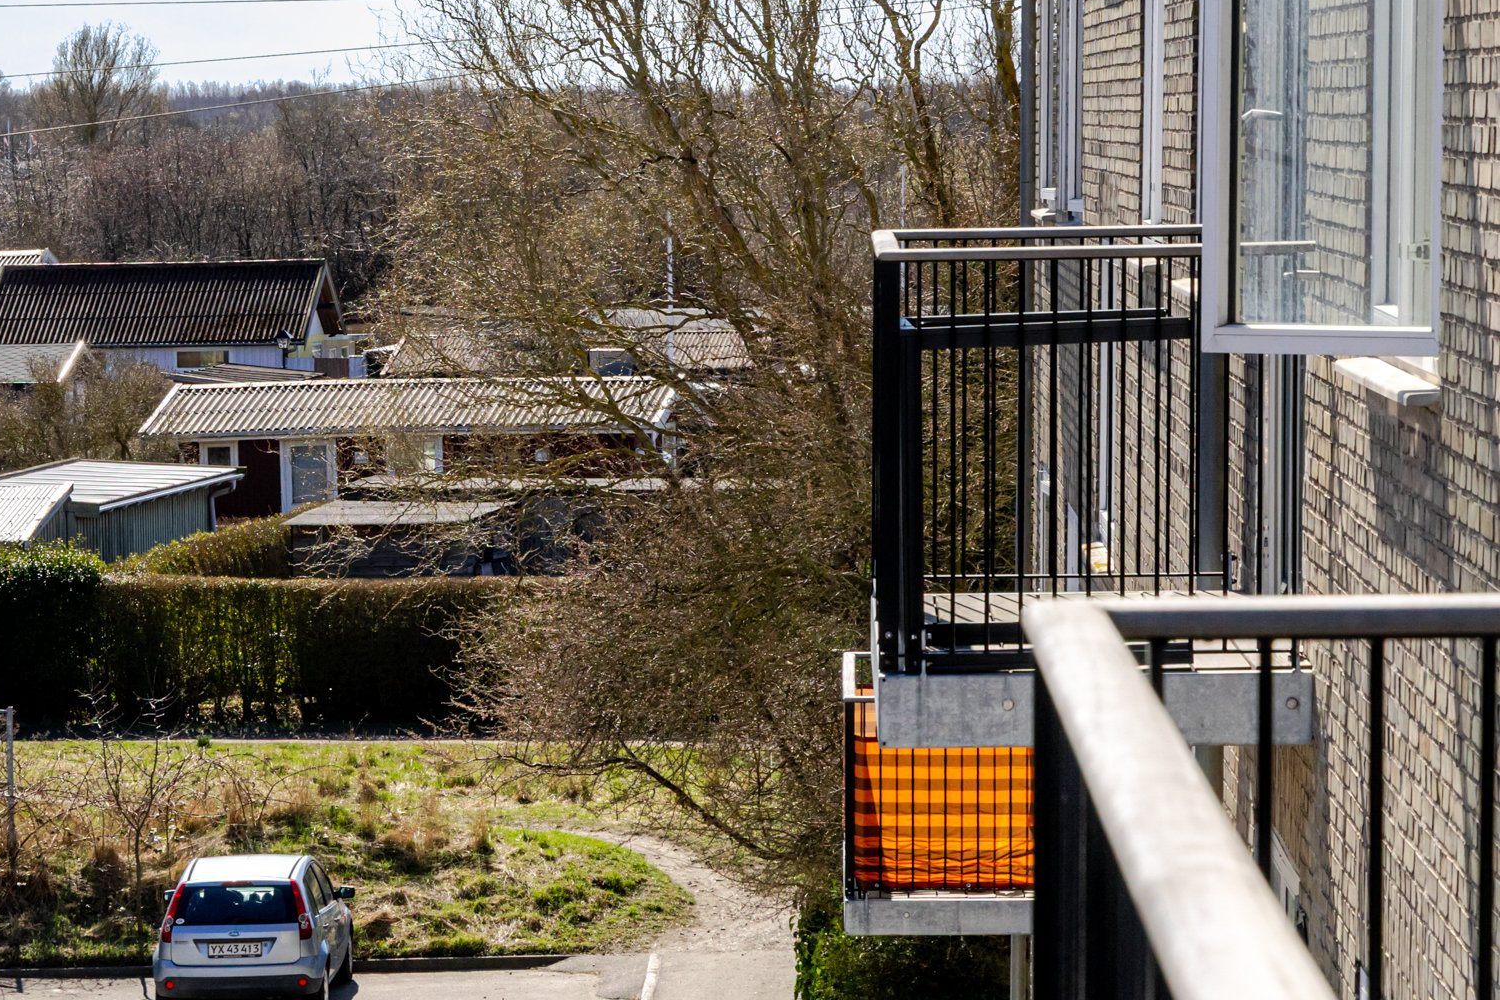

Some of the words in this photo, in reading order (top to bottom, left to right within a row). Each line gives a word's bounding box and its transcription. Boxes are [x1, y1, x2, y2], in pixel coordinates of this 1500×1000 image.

[210, 945, 225, 954] YX
[226, 944, 239, 953] 43
[241, 944, 260, 953] 413
